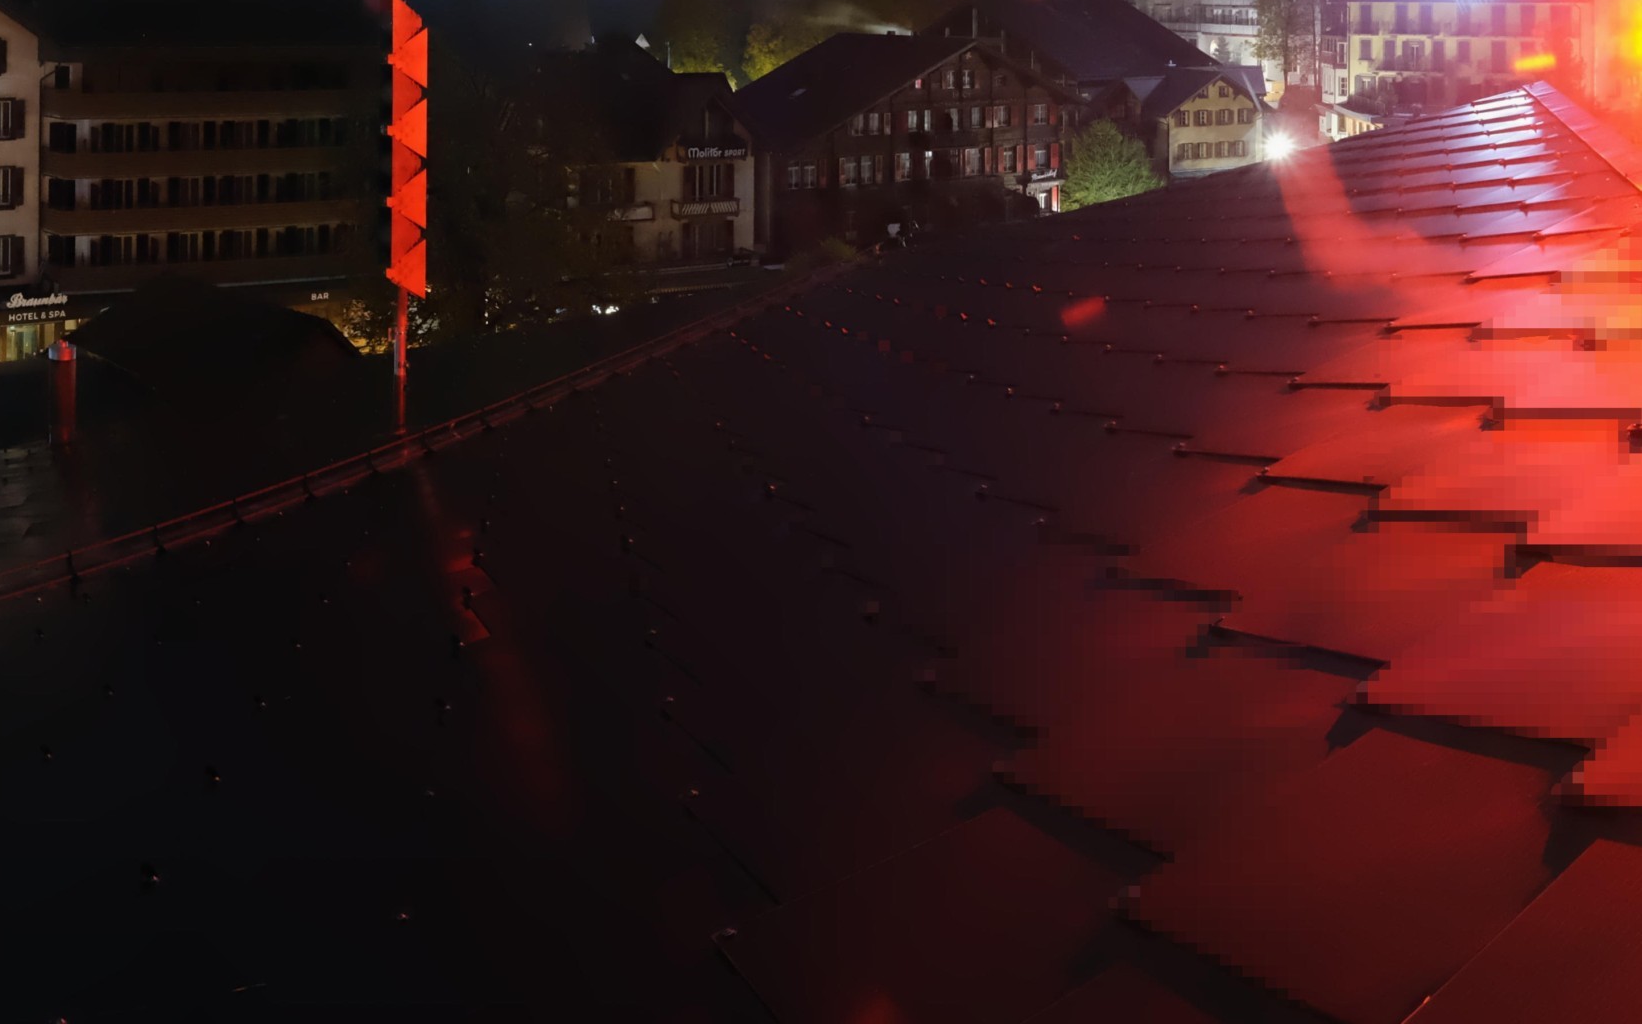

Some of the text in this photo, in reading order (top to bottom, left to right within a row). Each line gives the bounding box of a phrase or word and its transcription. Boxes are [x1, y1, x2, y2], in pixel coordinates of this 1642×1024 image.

[688, 147, 722, 159] Molitor
[311, 292, 329, 301] BAR
[8, 310, 66, 322] HOTEL & SPA
